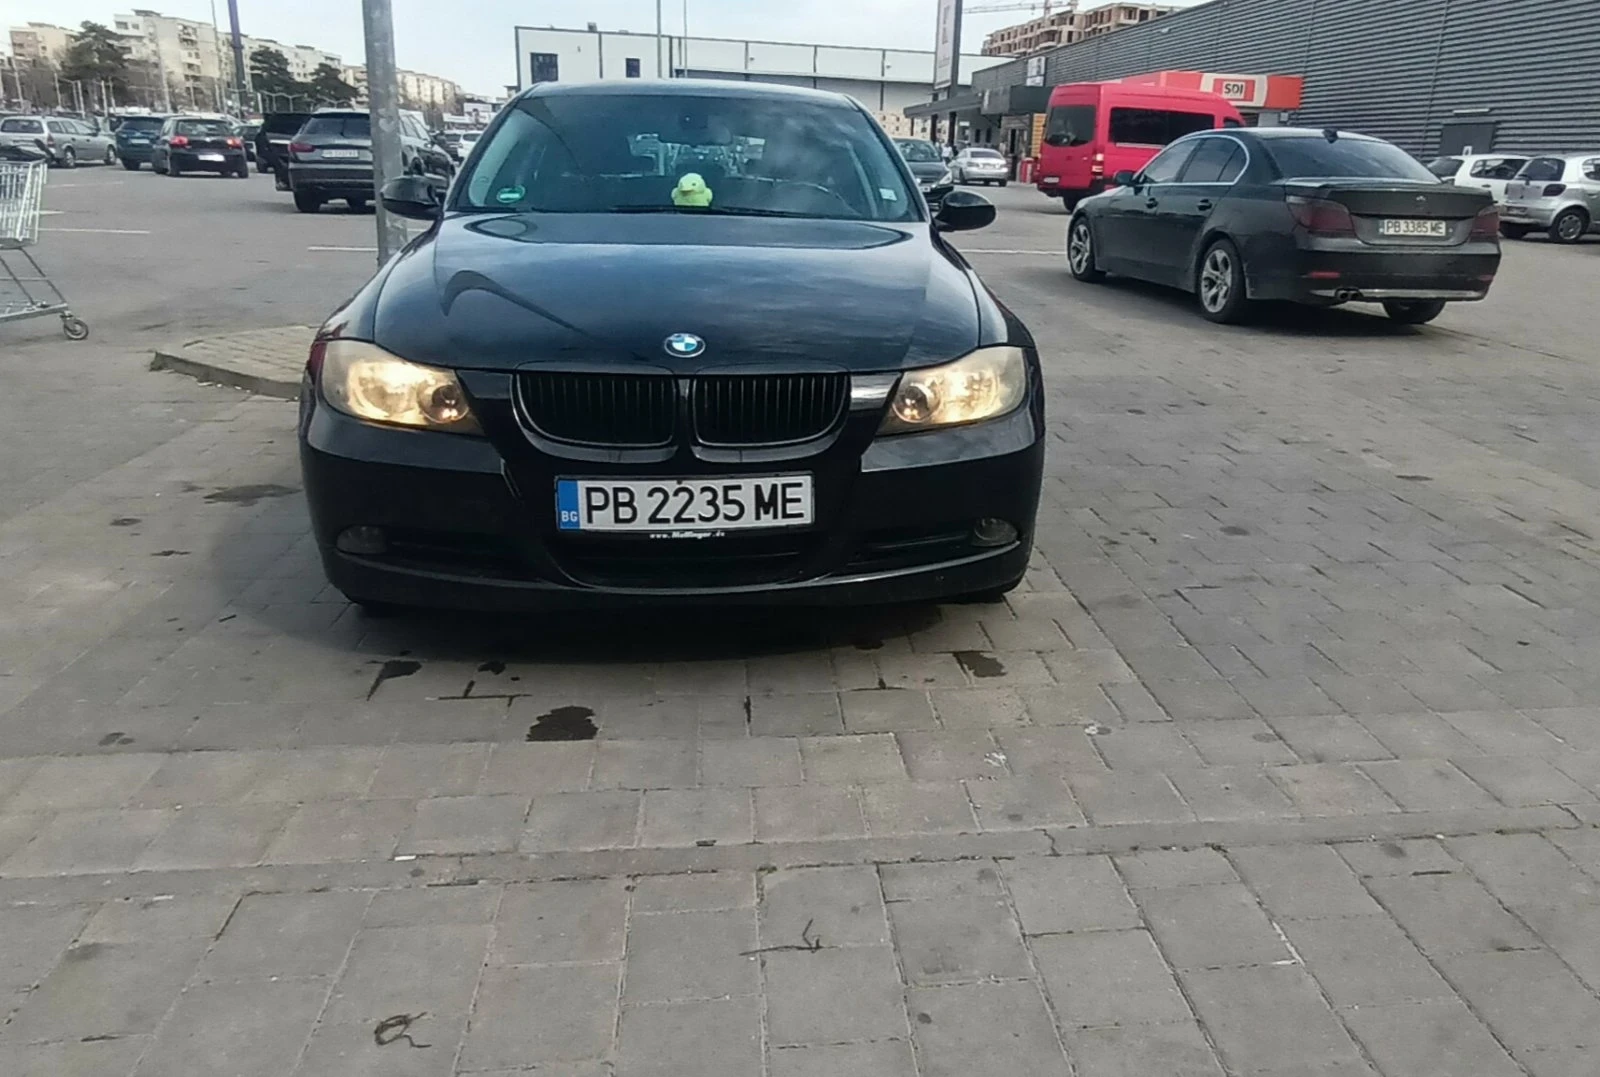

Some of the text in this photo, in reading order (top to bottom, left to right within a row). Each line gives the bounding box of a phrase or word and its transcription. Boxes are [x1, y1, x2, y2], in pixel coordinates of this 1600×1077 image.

[1386, 220, 1401, 233] PB
[586, 482, 805, 524] PB 2235 ME
[561, 510, 578, 522] BG
